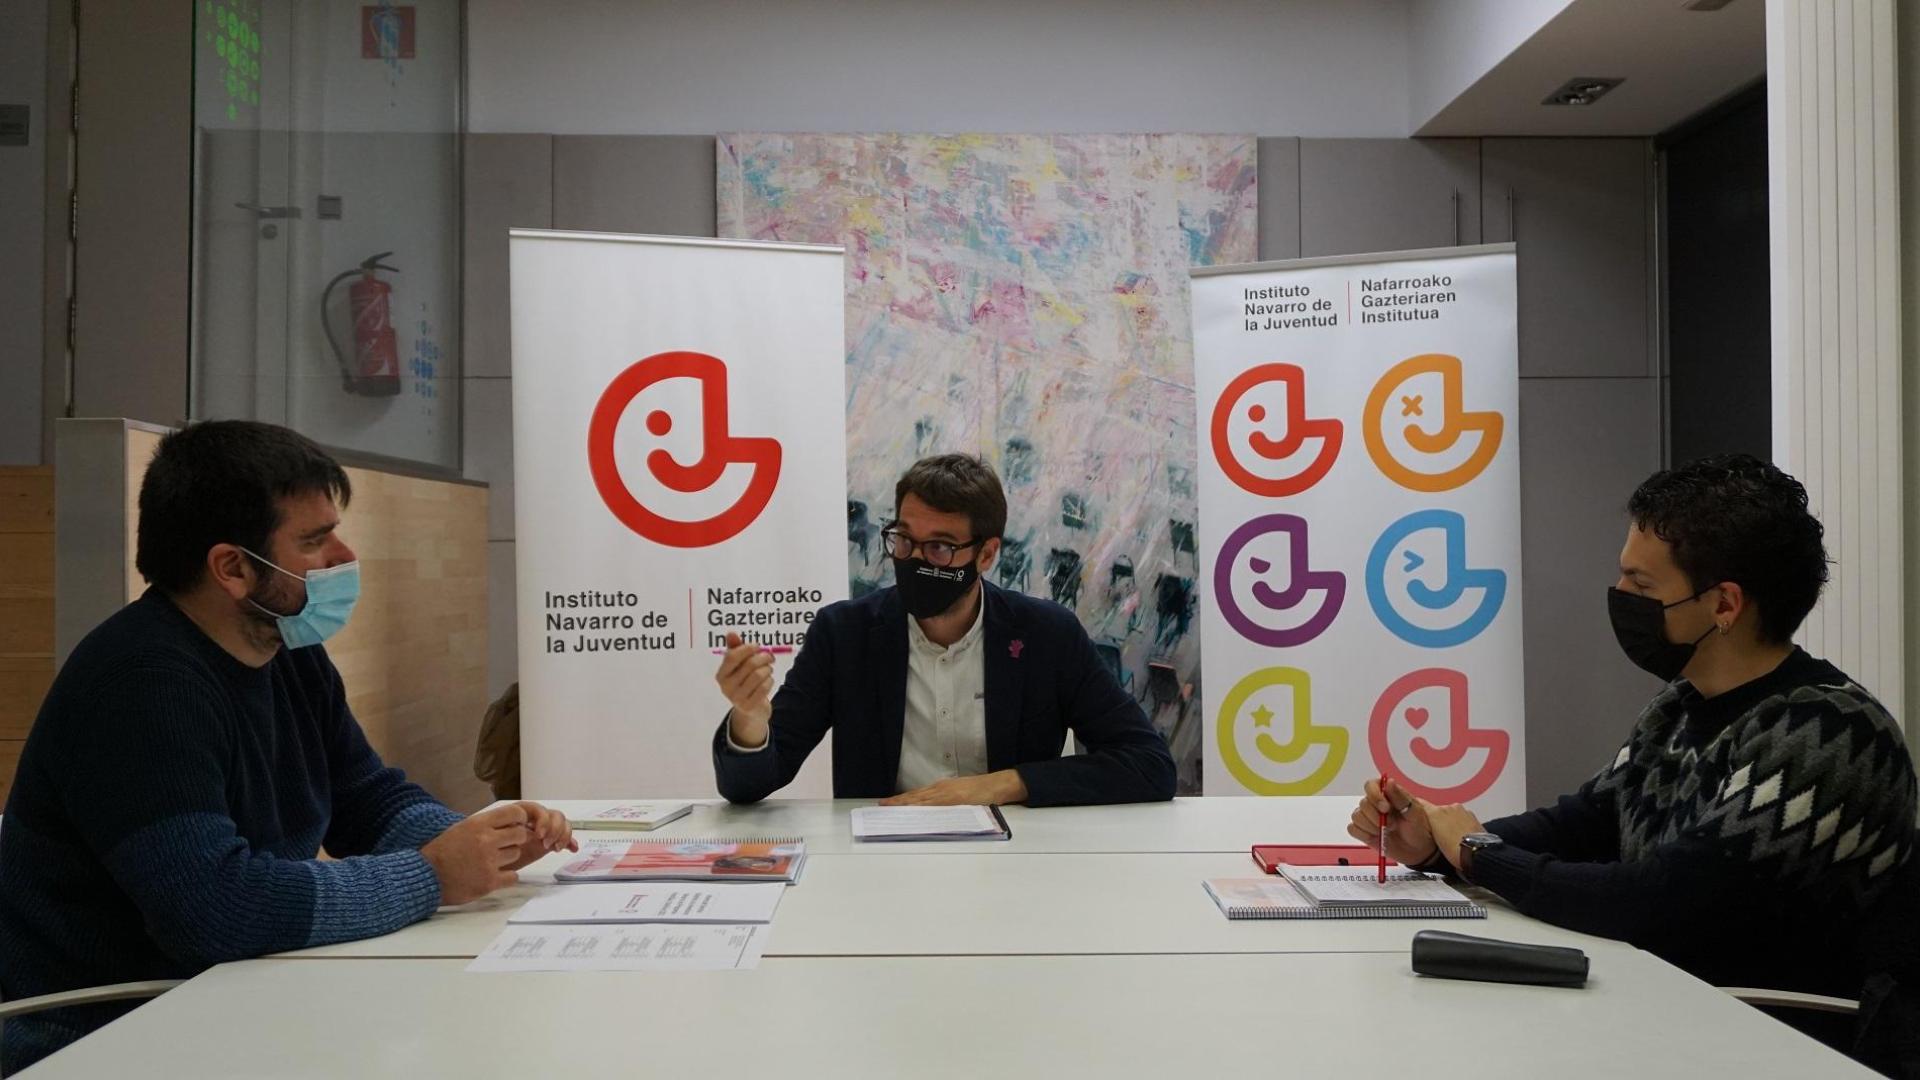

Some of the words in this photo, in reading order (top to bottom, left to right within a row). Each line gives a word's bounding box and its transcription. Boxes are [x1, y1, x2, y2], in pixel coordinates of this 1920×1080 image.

[1361, 274, 1452, 292] Nafarroako
[1244, 285, 1310, 300] Instituto
[1361, 290, 1456, 308] Gazteriaren
[1244, 300, 1307, 315] Navarro
[1312, 298, 1332, 311] de
[1245, 319, 1258, 331] la
[1263, 313, 1338, 330] Juventud
[1361, 308, 1439, 323] Institutua
[545, 591, 638, 608] Instituto
[707, 587, 822, 604] Nafarroako
[545, 612, 634, 631] Navarro
[641, 611, 668, 628] de
[707, 608, 816, 626] Gazteriare
[546, 636, 565, 653] la
[573, 632, 675, 652] Juventud
[708, 631, 805, 648] Intitutua
